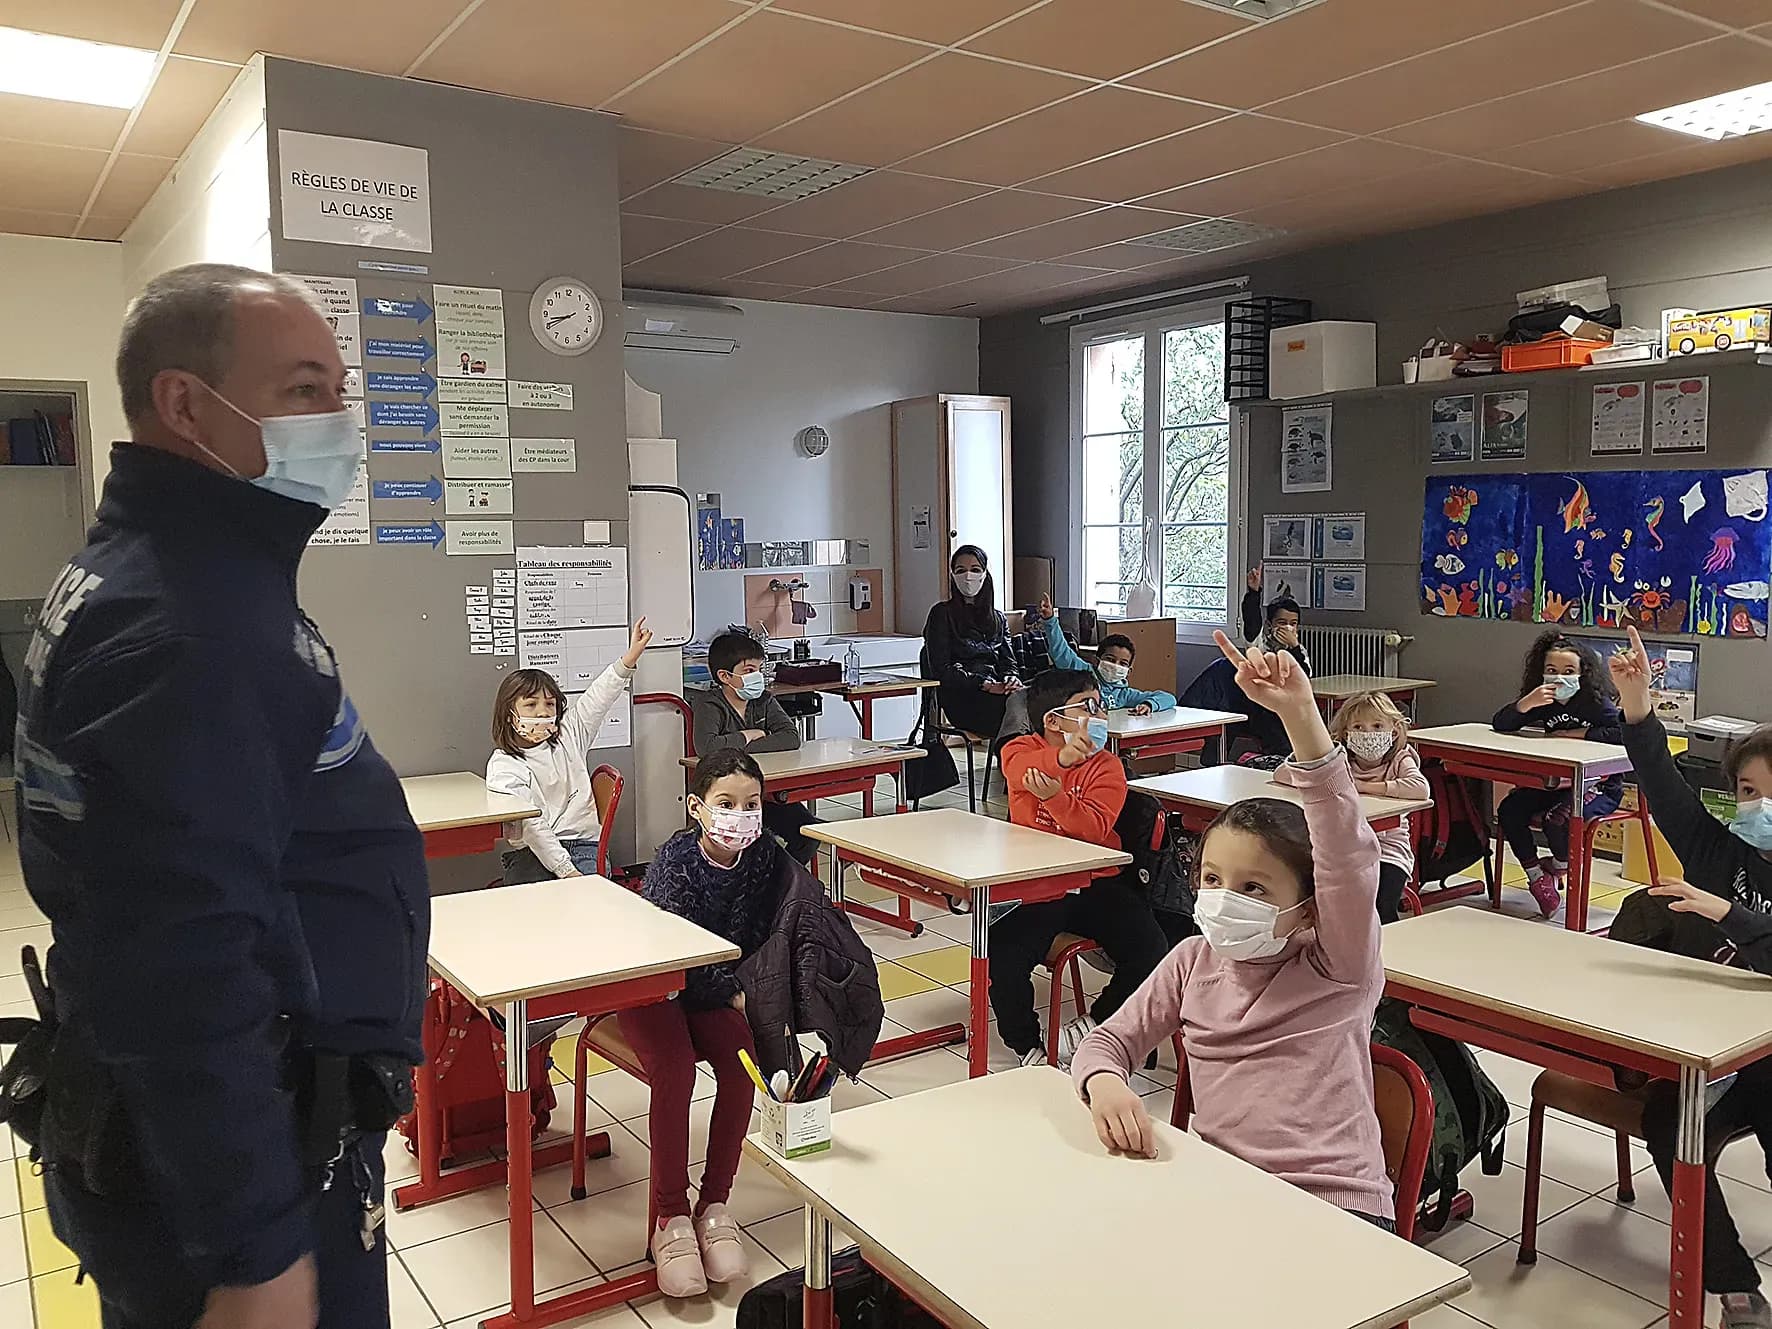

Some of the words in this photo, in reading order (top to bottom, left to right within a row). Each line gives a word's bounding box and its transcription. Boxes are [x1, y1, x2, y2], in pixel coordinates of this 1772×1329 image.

[291, 169, 347, 190] RÈGLES
[351, 178, 370, 193] DE
[373, 181, 396, 196] VIE
[400, 185, 418, 199] DE
[321, 200, 339, 215] LA
[342, 203, 393, 220] CLASSE
[319, 288, 339, 296] calme
[340, 288, 348, 296] et
[554, 291, 561, 299] 11
[566, 289, 573, 297] 12
[329, 298, 351, 306] quand
[584, 303, 590, 311] 2
[543, 310, 549, 318] 9
[587, 315, 593, 323] 3
[554, 331, 560, 339] 7
[575, 334, 581, 342] 5
[564, 336, 570, 344] 6
[453, 380, 476, 388] gardien
[467, 405, 492, 413] déplacer
[458, 422, 491, 430] permission
[524, 447, 536, 455] Être
[324, 527, 332, 536] je
[343, 528, 369, 536] quelque
[311, 537, 333, 545] chose,
[518, 560, 547, 568] Tableau
[561, 559, 612, 568] responsabilités
